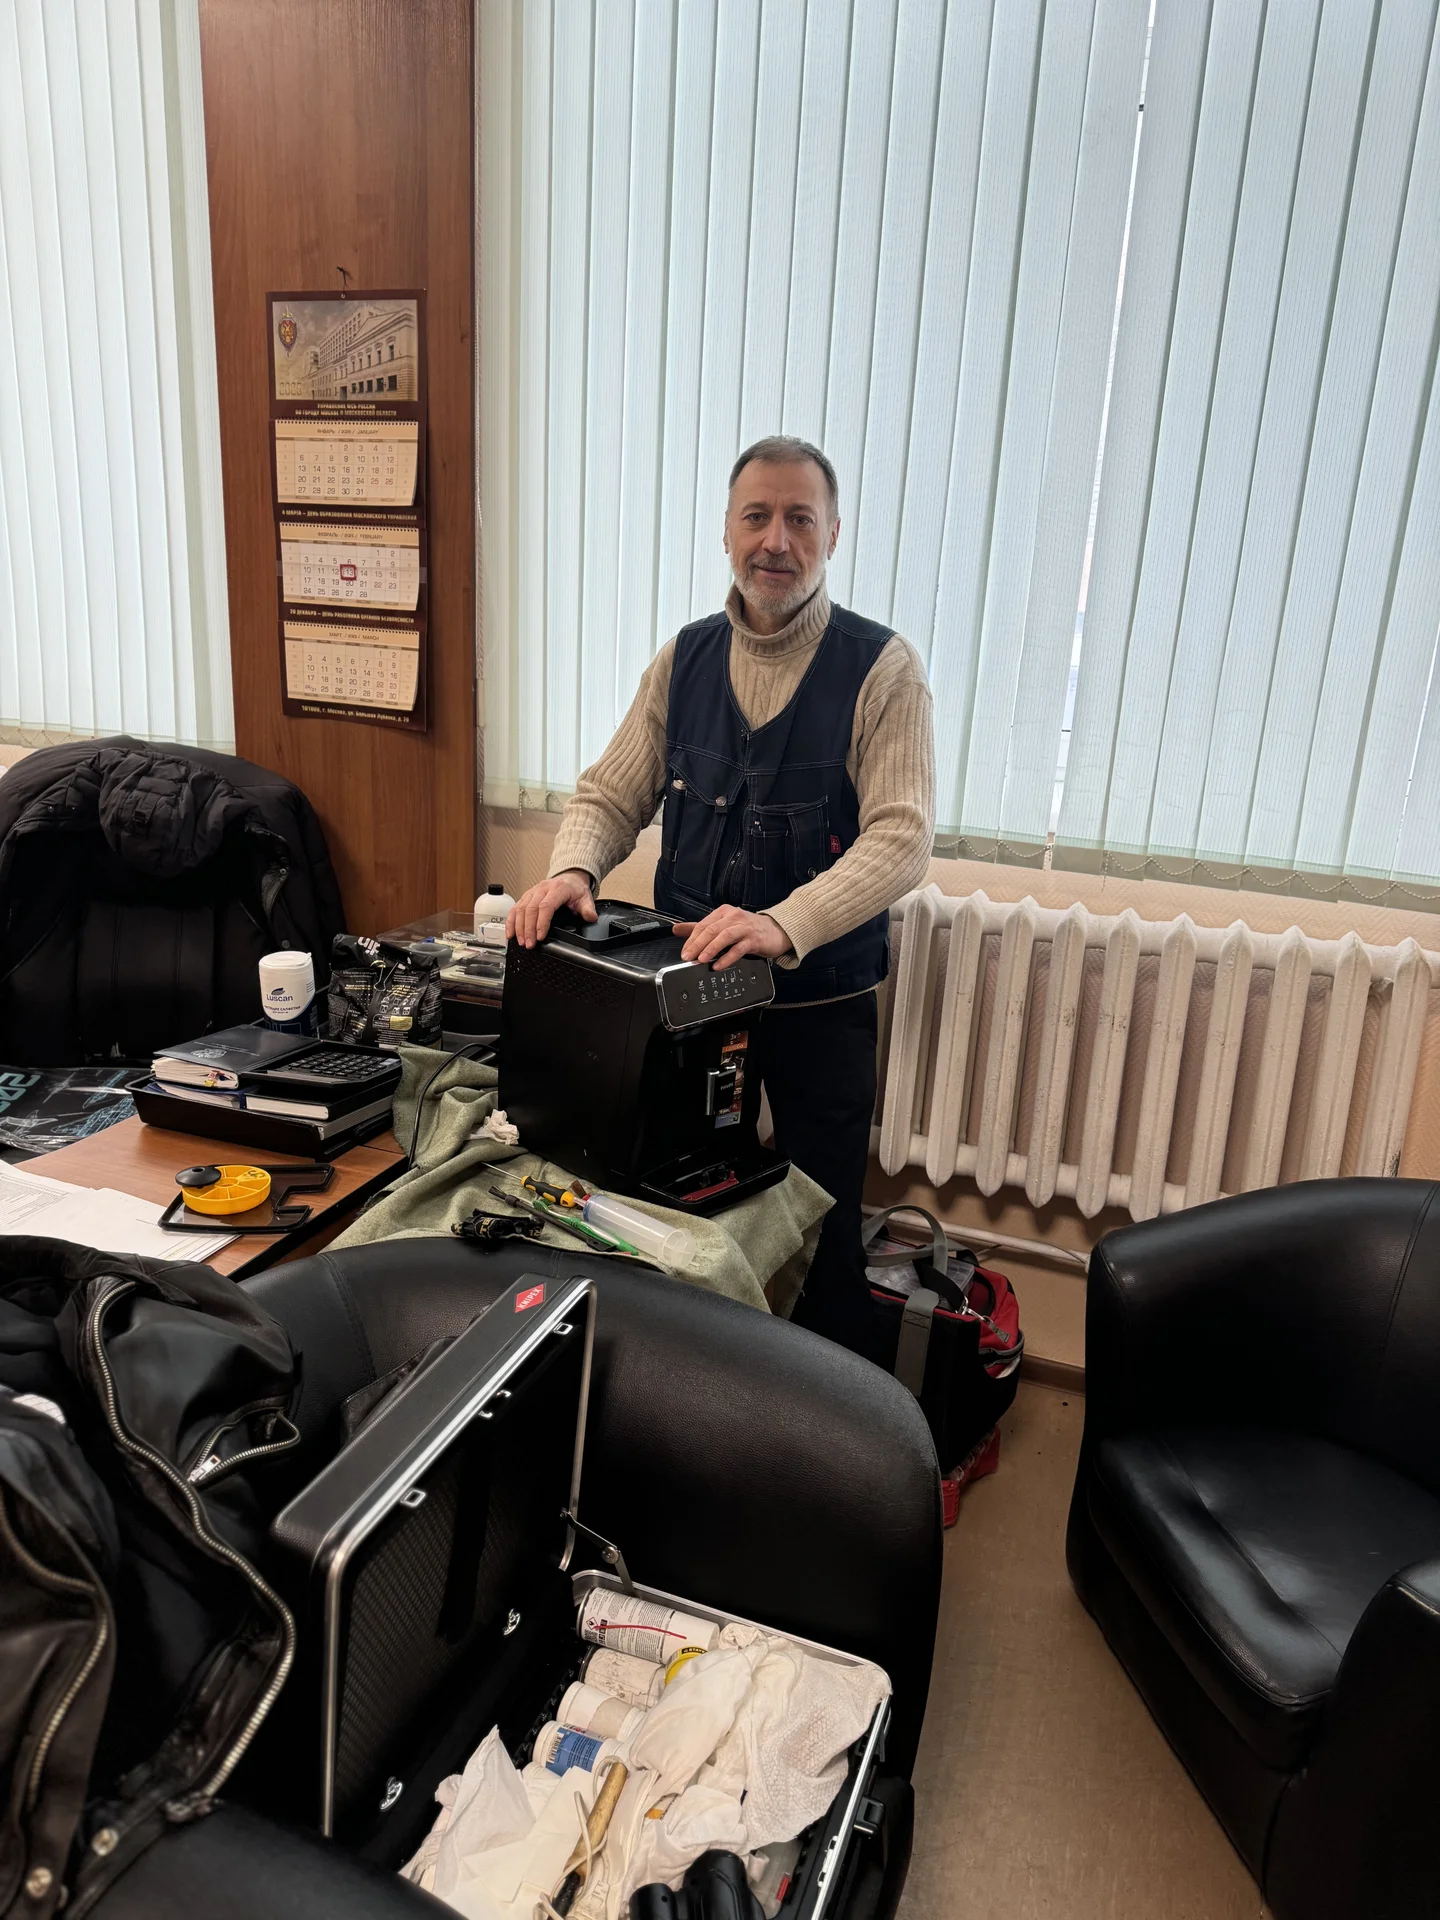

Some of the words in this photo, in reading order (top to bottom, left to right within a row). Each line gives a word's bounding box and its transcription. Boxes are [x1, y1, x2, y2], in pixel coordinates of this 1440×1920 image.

[279, 381, 301, 396] 2025
[327, 708, 346, 716] Москва,
[377, 712, 397, 722] Лубянка,
[266, 993, 293, 1002] Luscan
[517, 1288, 542, 1309] KNIPEX
